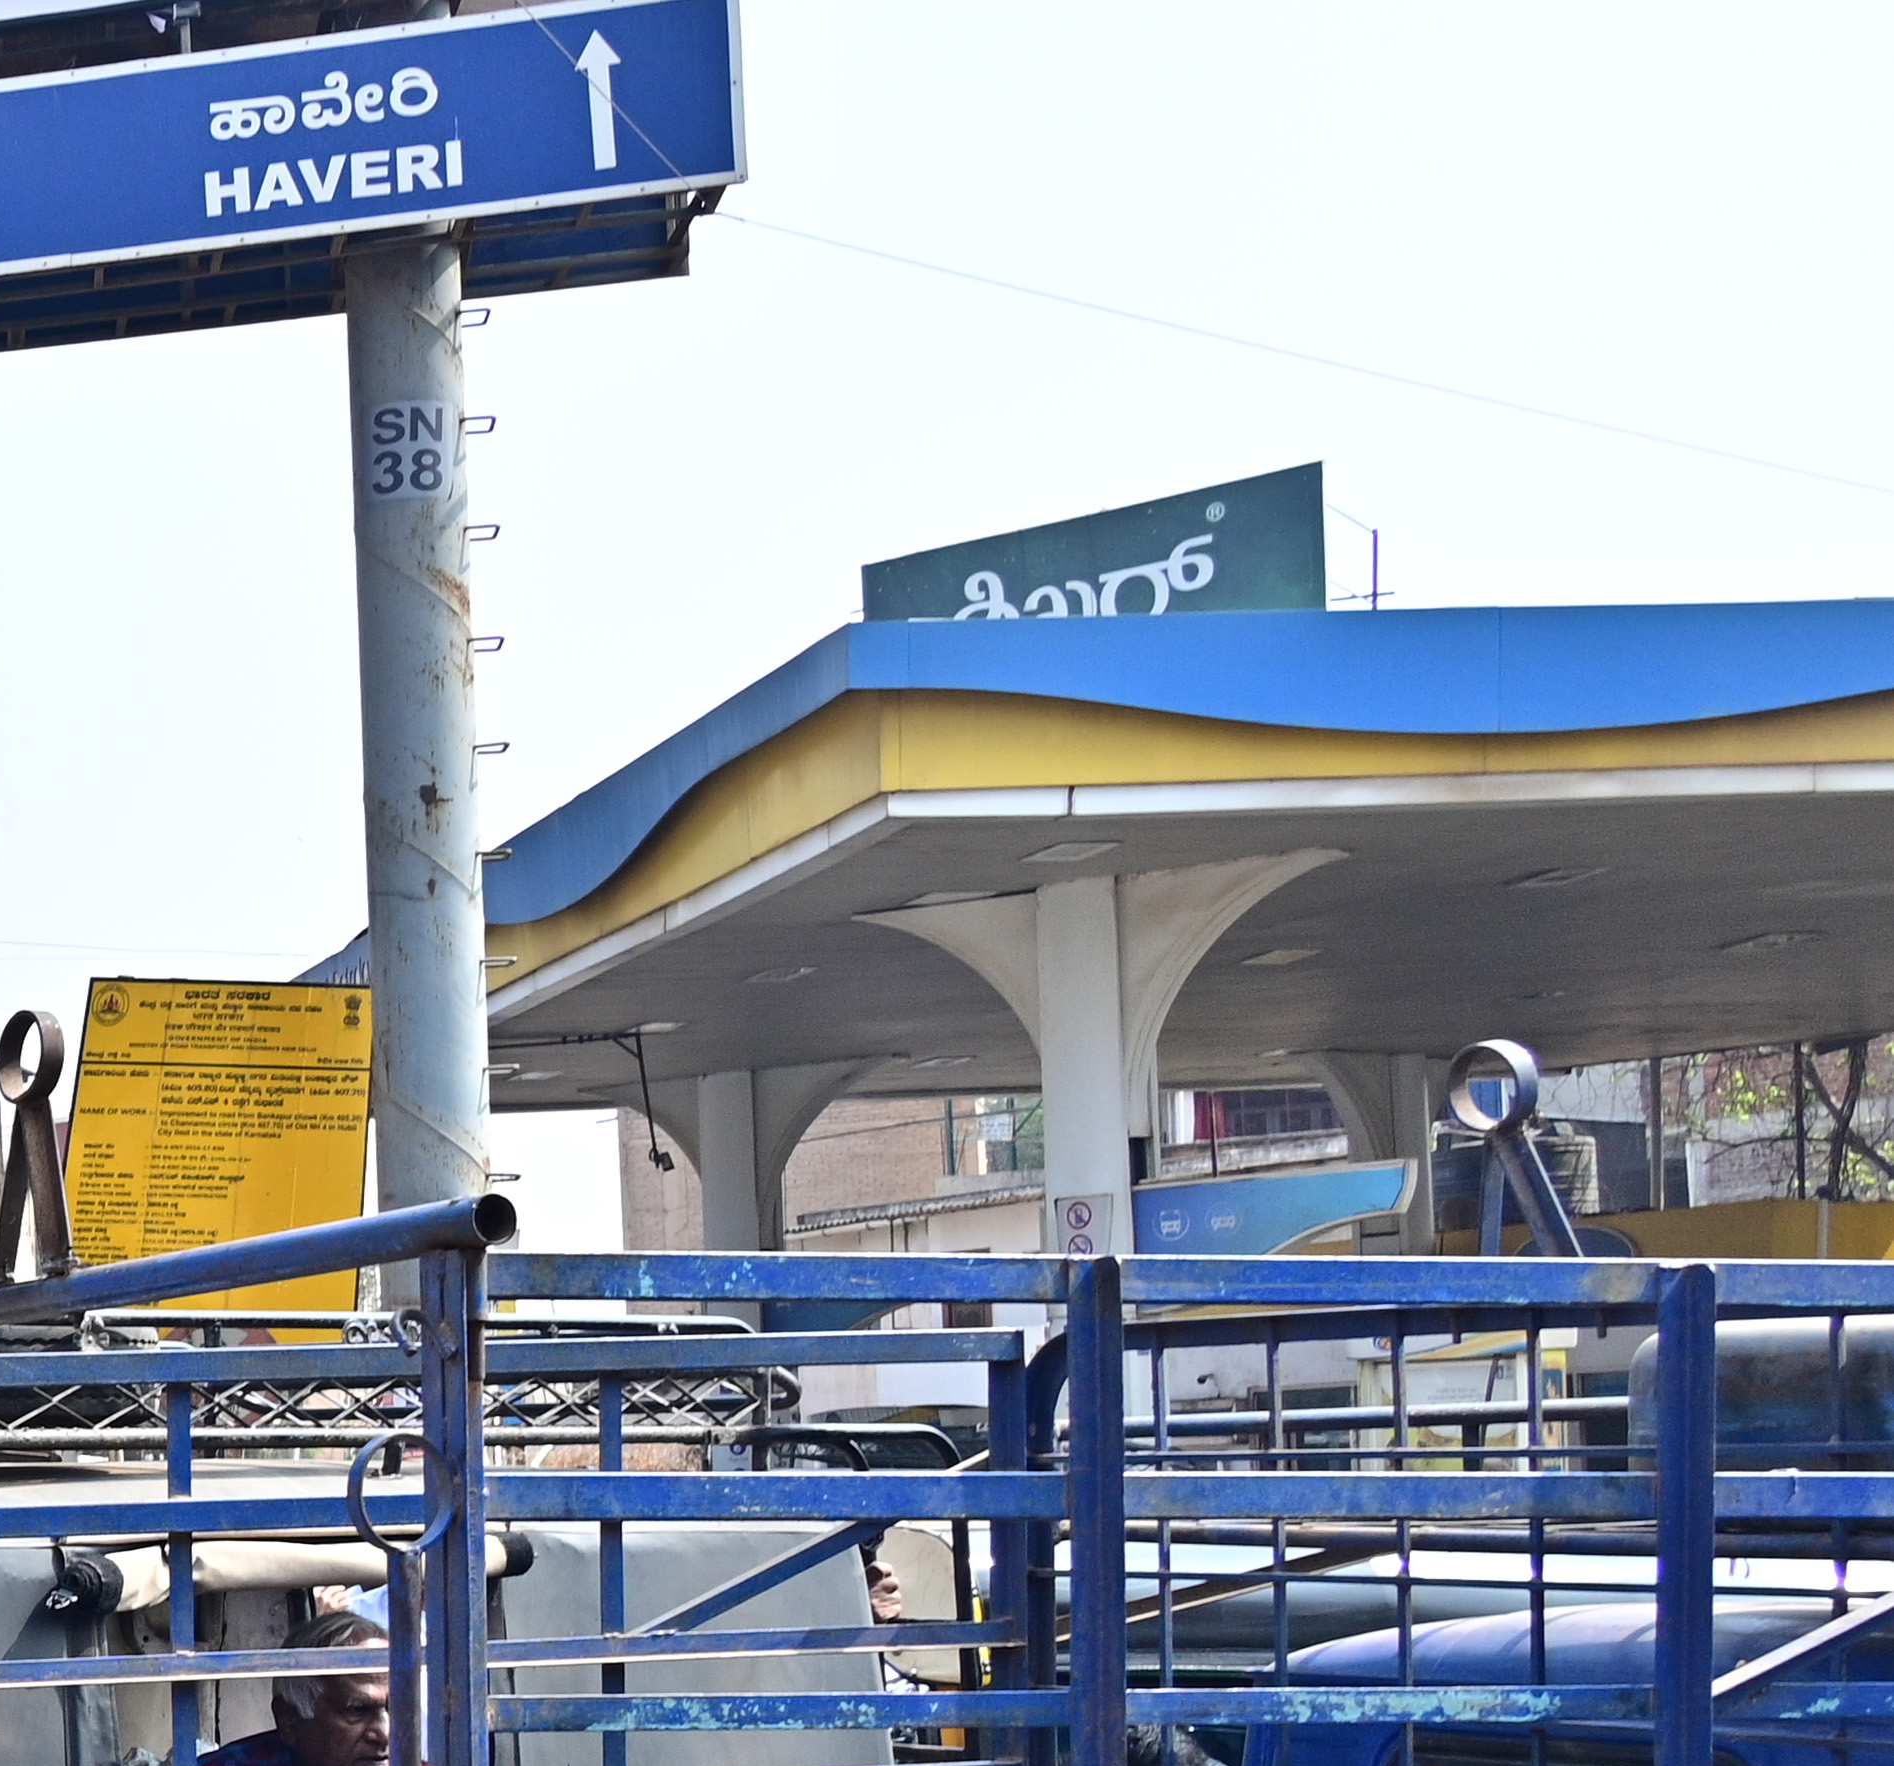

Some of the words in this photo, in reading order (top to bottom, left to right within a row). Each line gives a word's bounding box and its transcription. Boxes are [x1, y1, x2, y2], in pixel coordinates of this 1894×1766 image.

[210, 67, 439, 140] ಹಾವೇರಿ
[204, 140, 463, 217] HAVERI
[373, 406, 443, 445] SN
[372, 448, 443, 494] 38
